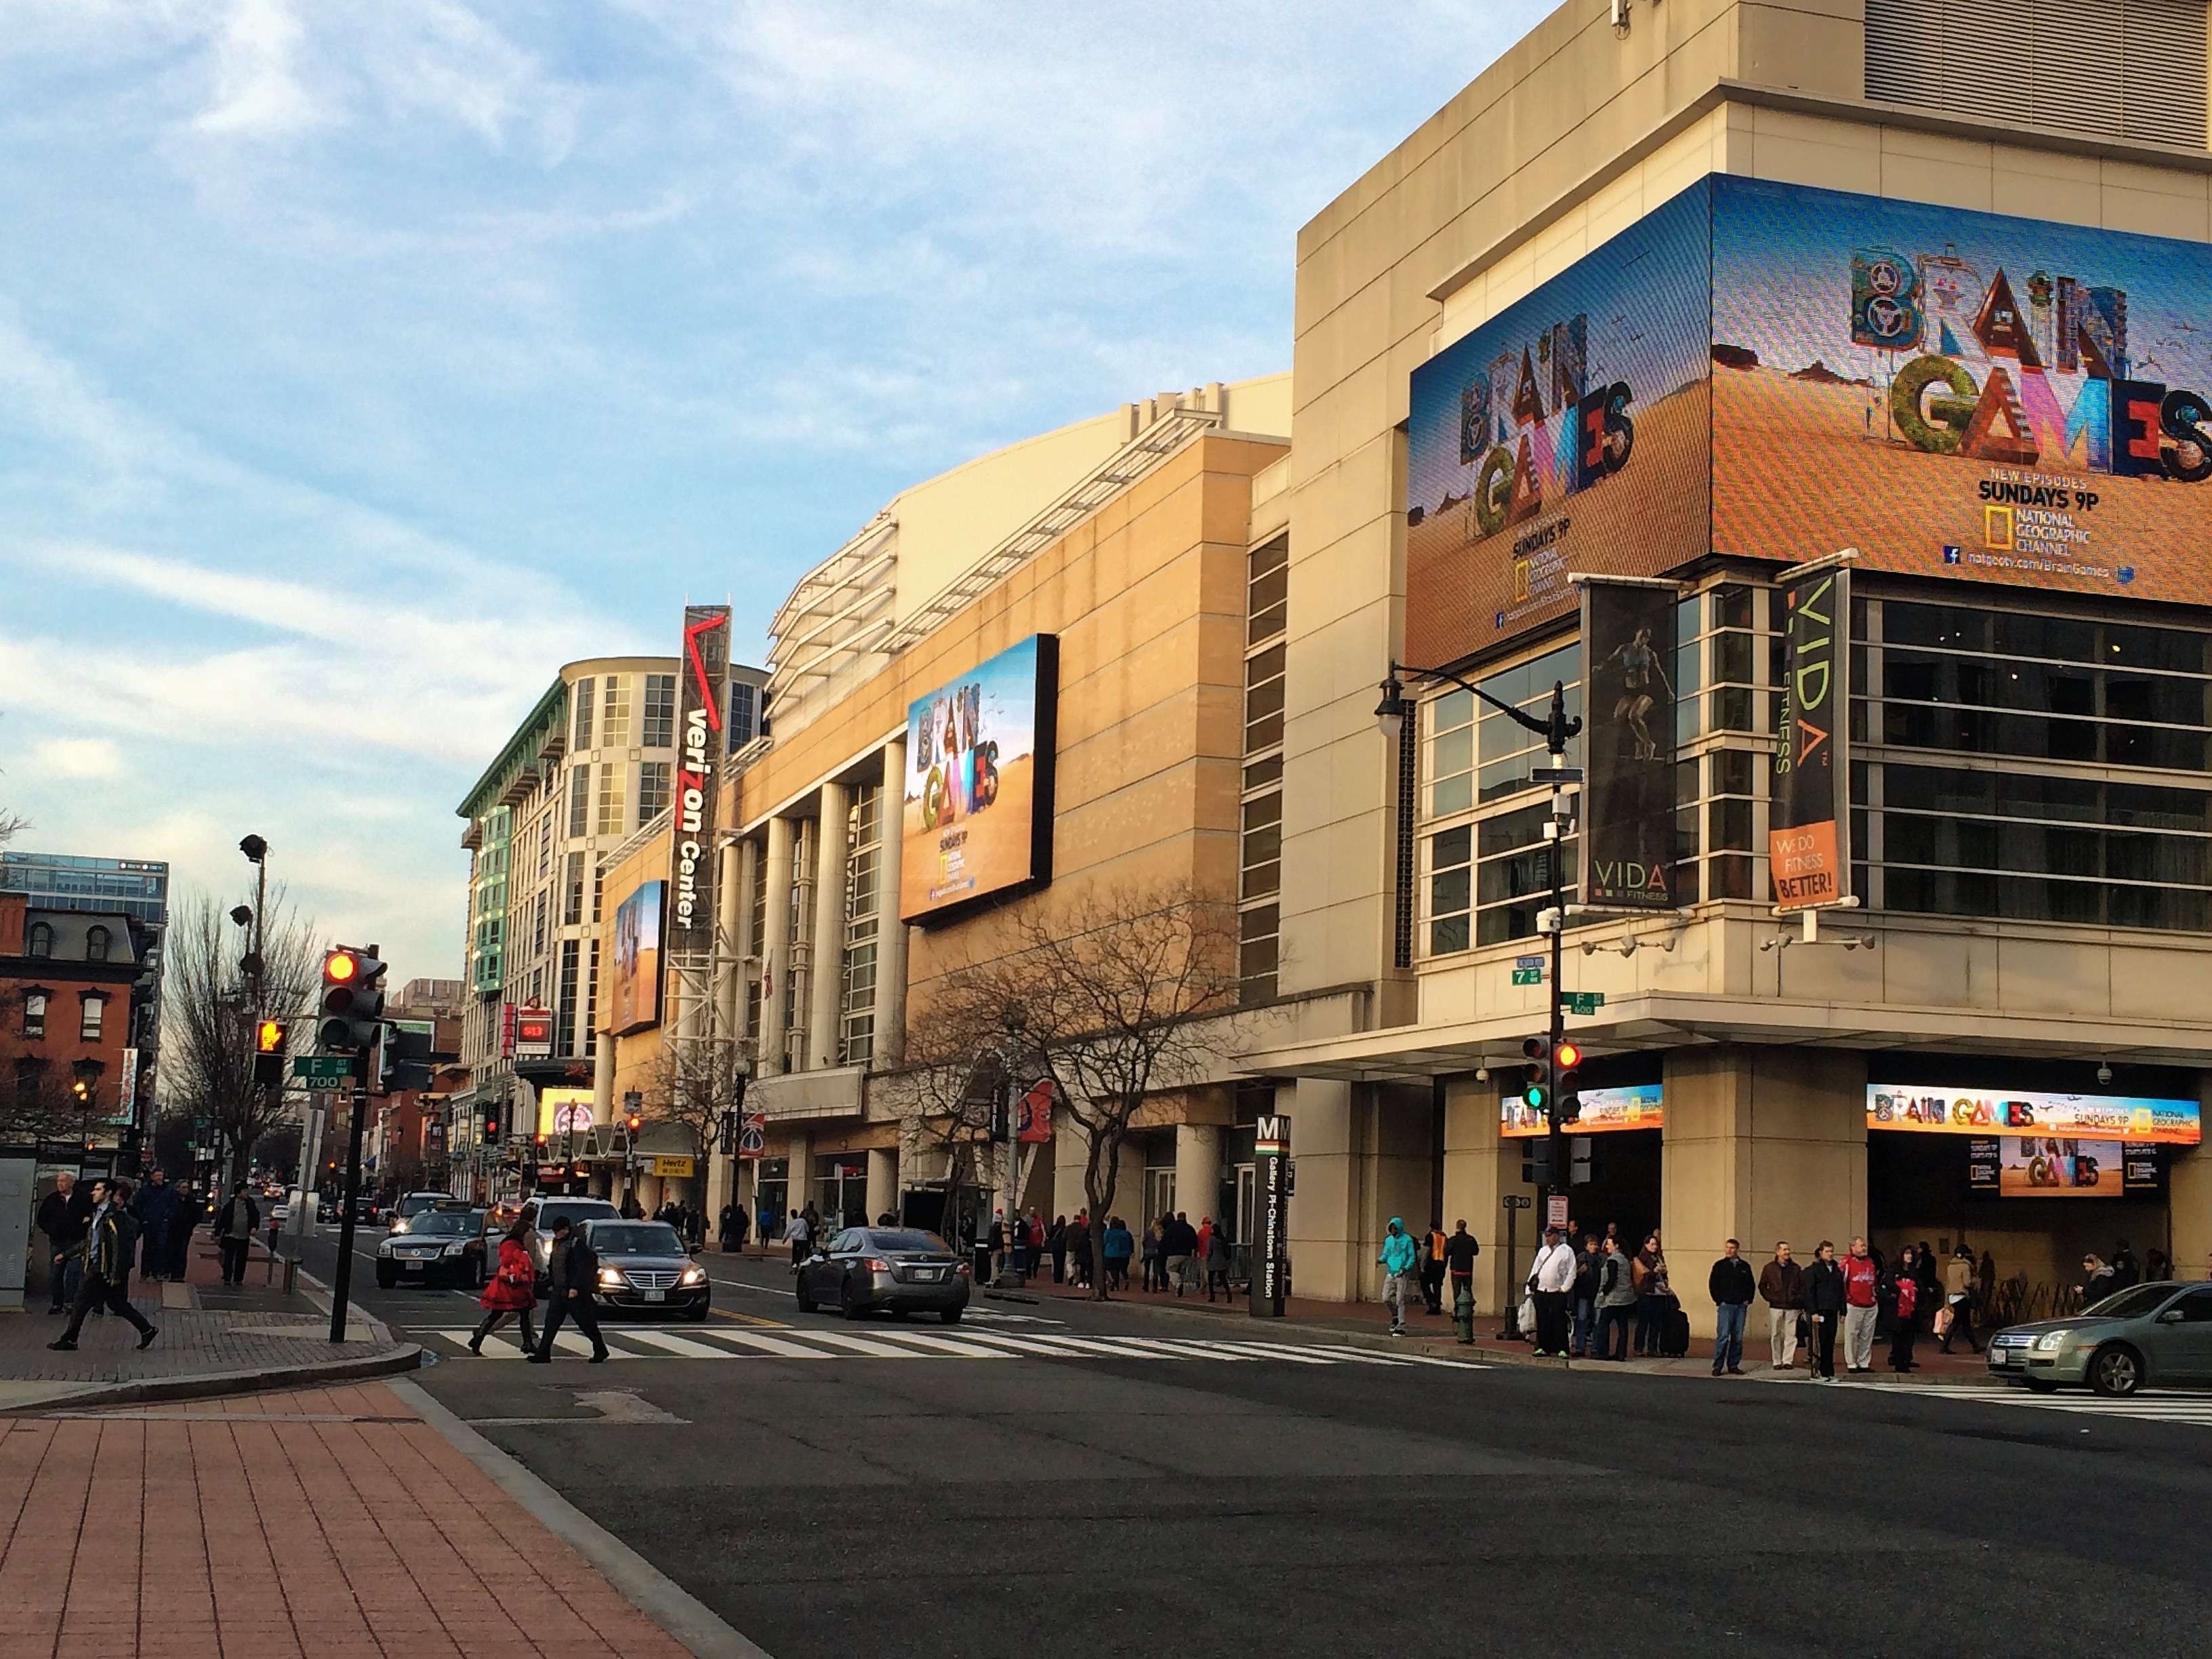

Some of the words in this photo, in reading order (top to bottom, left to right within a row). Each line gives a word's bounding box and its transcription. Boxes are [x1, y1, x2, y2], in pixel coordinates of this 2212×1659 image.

[1851, 245, 2128, 380] BRAIN
[1460, 314, 1587, 466] BRAIN
[1891, 353, 2212, 481] GAMES
[1475, 381, 1634, 537] GAMES
[1990, 467, 2020, 482] NEW
[2024, 471, 2087, 489] EPISODES
[1979, 480, 2068, 509] SUNDAYS
[2074, 492, 2100, 512] 9P
[2015, 508, 2076, 527] NATIONAL
[1797, 577, 1832, 768] VIDA
[917, 682, 980, 773] BRAIN
[1776, 671, 1791, 775] FITNESS
[674, 708, 711, 833] verizon
[924, 740, 998, 830] GAMES
[1798, 834, 1815, 851] DO
[1594, 859, 1667, 890] VIDA
[1785, 853, 1824, 873] FITNESS
[677, 840, 701, 930] Center
[1627, 890, 1669, 901] FITNESS
[1778, 872, 1832, 899] BETTER!
[1515, 971, 1525, 983] 7
[1576, 994, 1584, 1004] F
[309, 1076, 338, 1088] 700
[311, 1059, 322, 1074] F
[1875, 1090, 1945, 1124] BRAIN
[1952, 1098, 2034, 1128] GAMES
[2074, 1113, 2115, 1125] SUNDAYS
[2118, 1115, 2129, 1126] 9P
[2152, 1109, 2184, 1119] NATIONAL
[1257, 1117, 1279, 1141] M
[1267, 1156, 1279, 1192] Gallery
[1265, 1261, 1275, 1299] Station
